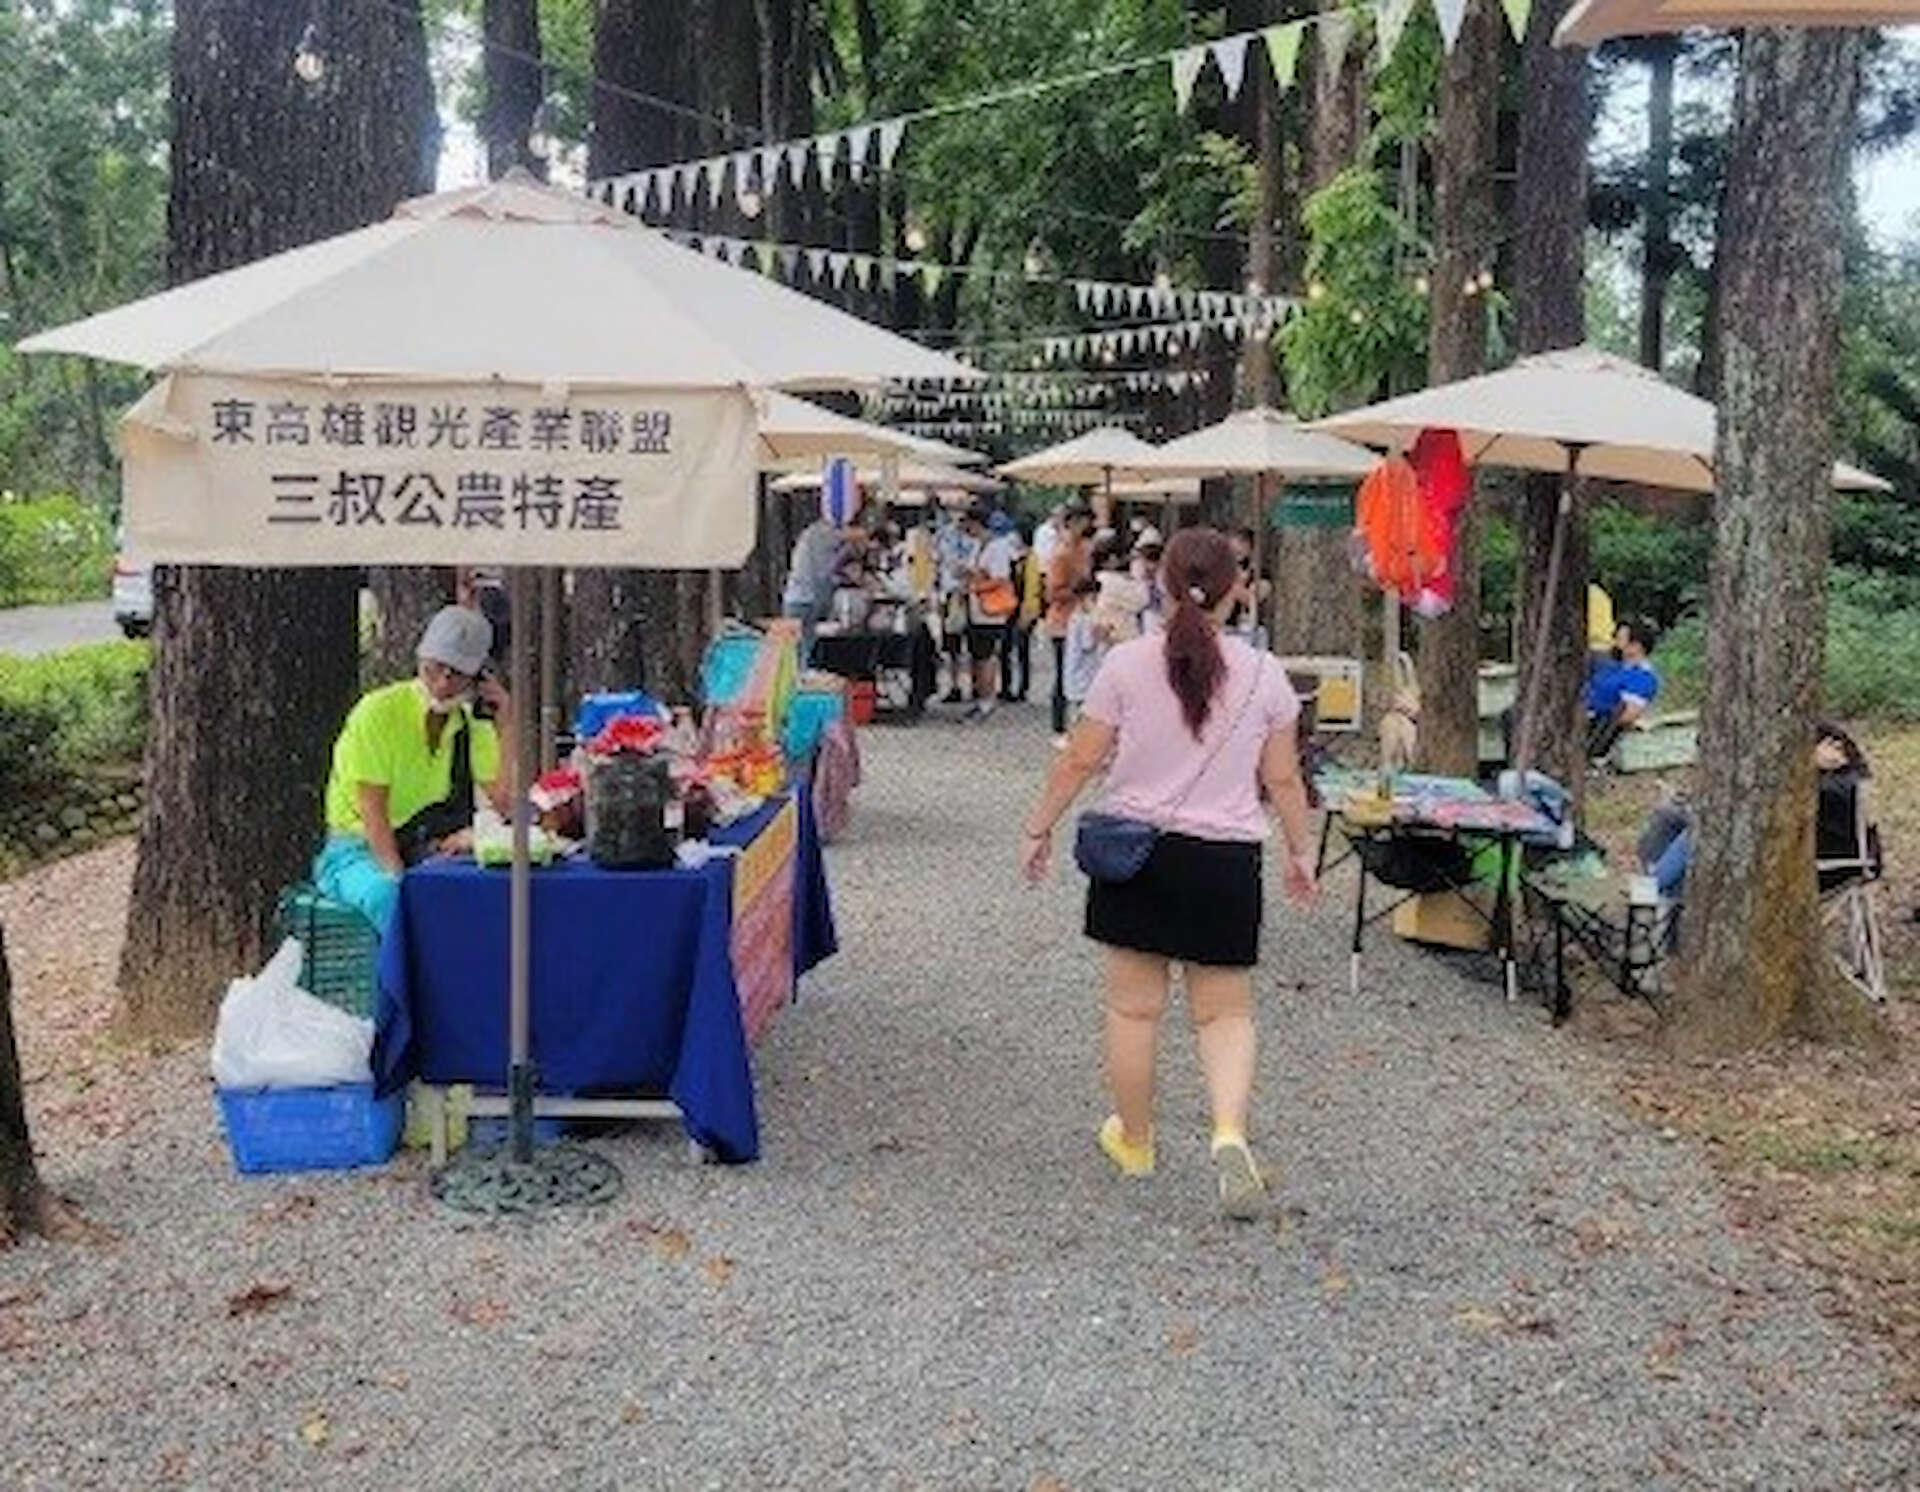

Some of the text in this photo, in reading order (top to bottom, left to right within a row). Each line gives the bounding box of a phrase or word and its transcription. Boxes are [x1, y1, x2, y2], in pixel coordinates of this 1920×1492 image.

[211, 399, 672, 454] 東高雄觀光產業聯盟
[267, 471, 623, 531] 三叔公農特產
